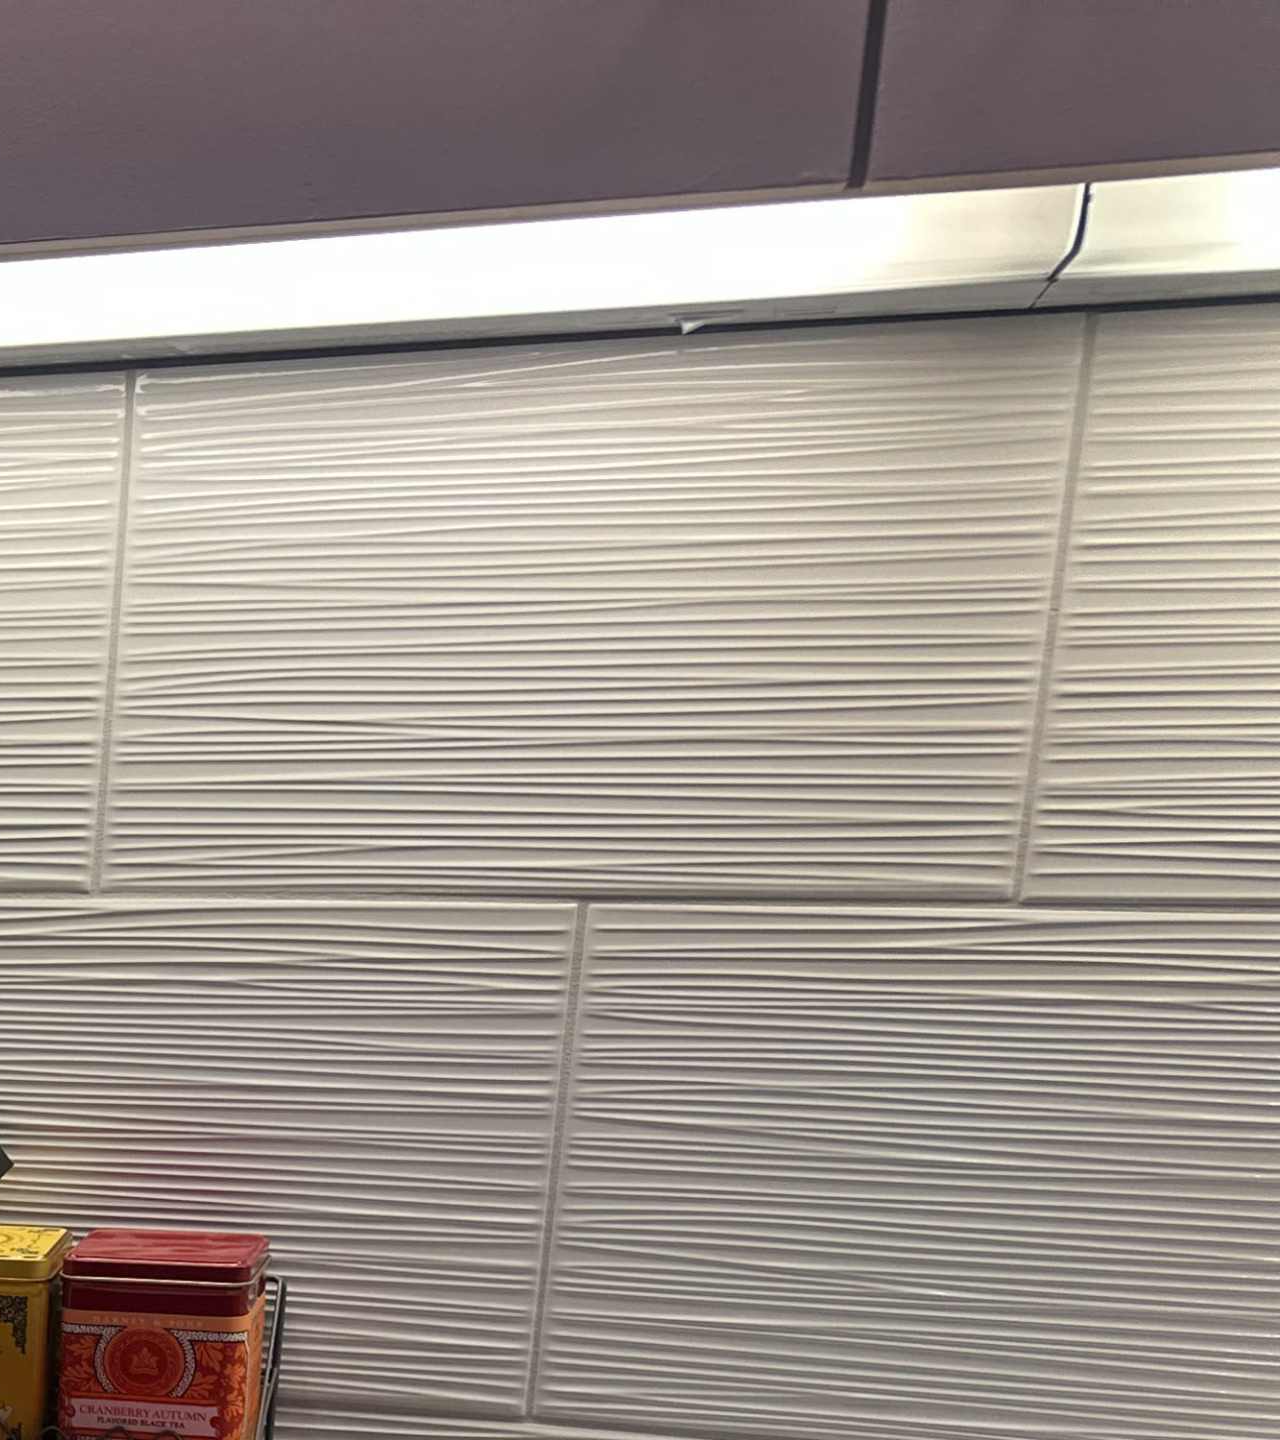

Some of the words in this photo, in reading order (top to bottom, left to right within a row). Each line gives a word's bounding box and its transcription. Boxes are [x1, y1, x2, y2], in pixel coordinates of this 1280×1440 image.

[79, 1403, 151, 1419] CRANBERRY
[153, 1408, 208, 1422] AUTUMN
[97, 1417, 139, 1427] FLAVORED
[140, 1418, 167, 1428] BLACK
[169, 1421, 185, 1429] TEA
